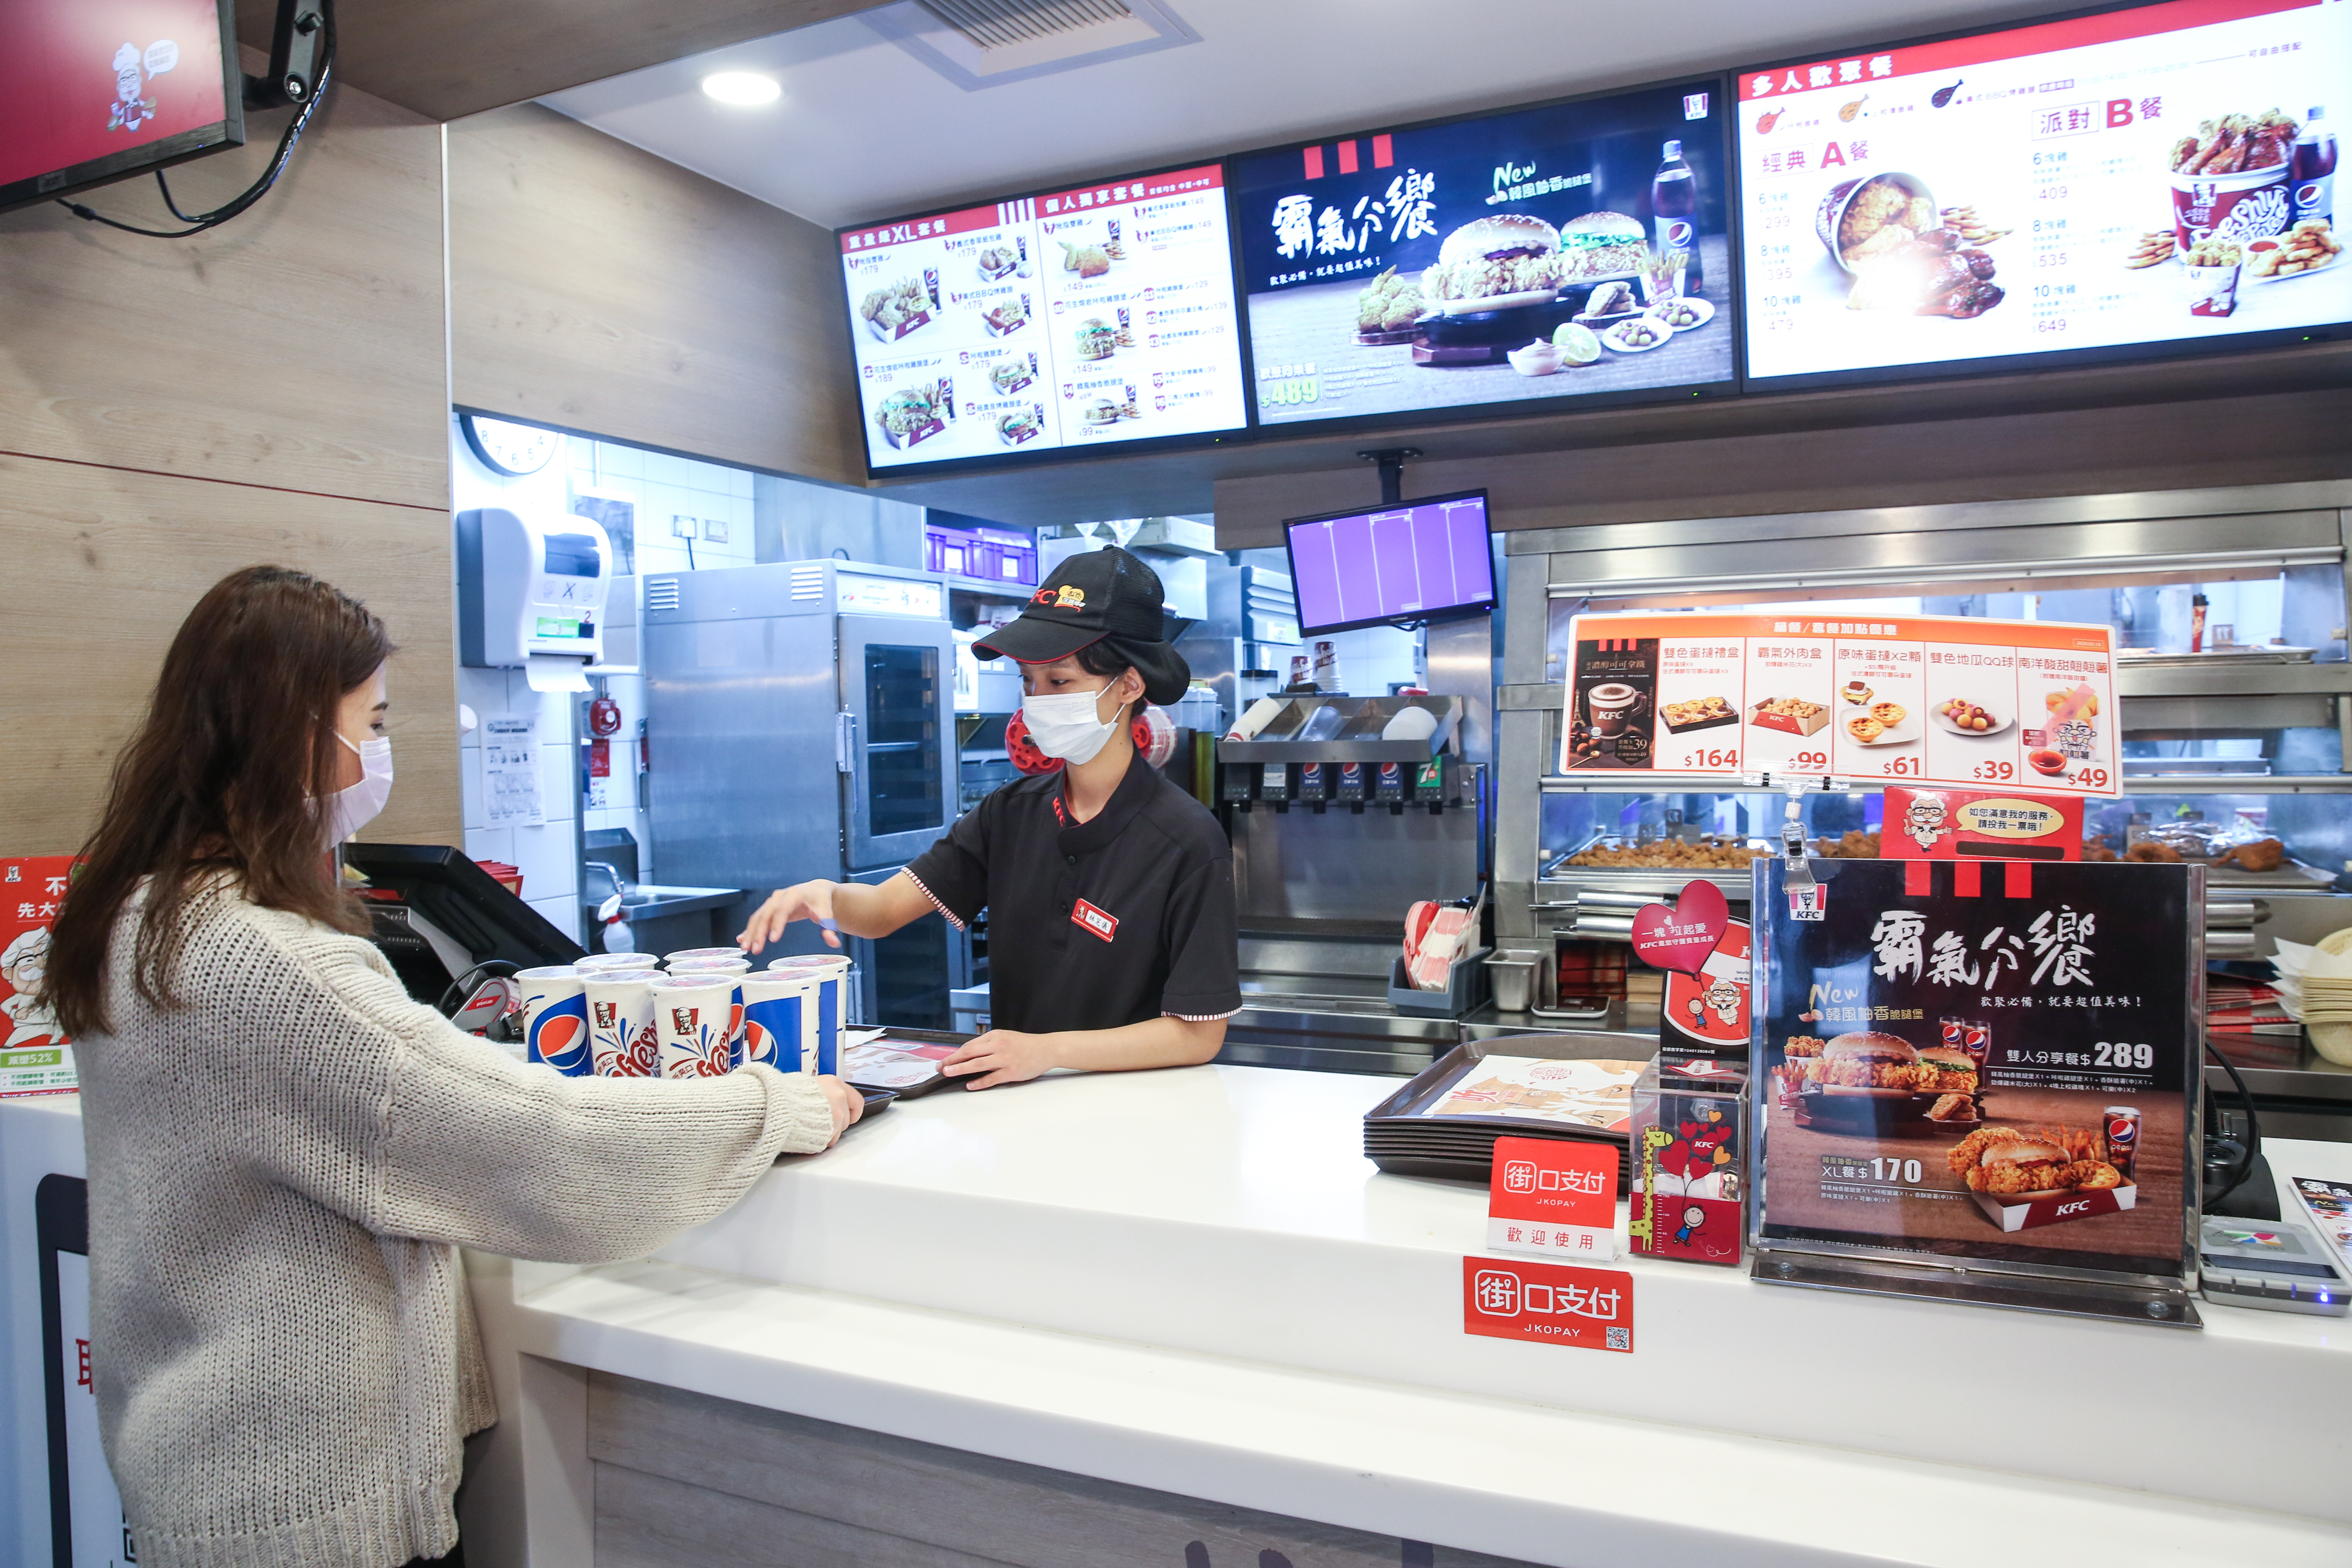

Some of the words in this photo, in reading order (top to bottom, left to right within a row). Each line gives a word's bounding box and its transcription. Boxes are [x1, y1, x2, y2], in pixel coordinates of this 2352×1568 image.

[1752, 54, 1893, 97] 多人歡聚餐
[2041, 107, 2089, 134] 派對
[1762, 149, 1806, 174] 經典
[1493, 160, 1537, 194] New
[1045, 183, 1145, 214] 個人獨享套餐
[1261, 378, 1319, 408] $489
[481, 430, 489, 442] 8
[537, 436, 543, 446] 4
[495, 446, 502, 457] 7
[512, 453, 519, 465] 6
[528, 448, 534, 460] 5
[1664, 647, 1739, 659] 雙色蛋撻禮盒
[1757, 647, 1822, 659] 霸氣外肉盒
[1838, 649, 1921, 663] 原味蛋撻X2顆
[1930, 653, 2014, 668] 雙色地瓜QQ球
[2018, 657, 2108, 675] 南洋酸甜翹翹薯
[1597, 710, 1624, 720] KFC
[1633, 739, 1648, 750] 39
[1684, 748, 1738, 768] $164
[1788, 751, 1826, 770] $99
[1883, 757, 1920, 775] $61
[1973, 761, 2013, 780] $39
[2068, 768, 2107, 787] $49
[1978, 819, 2042, 832] 請投我一票哦！
[1796, 910, 1819, 920] KFC
[1871, 904, 2096, 991] 霸氣分饗
[1809, 981, 1858, 1010] New
[1826, 1005, 1924, 1022] 韓風柚香脆腿堡
[1694, 1140, 1714, 1149] KFC
[1508, 1165, 1606, 1195] 街口支付
[1536, 1198, 1576, 1207] JKOPAY
[2056, 1199, 2090, 1216] KFC
[1507, 1227, 1593, 1250] 歡迎使用
[1479, 1276, 1621, 1320] 街口支付
[1524, 1323, 1581, 1337] JKOPAY
